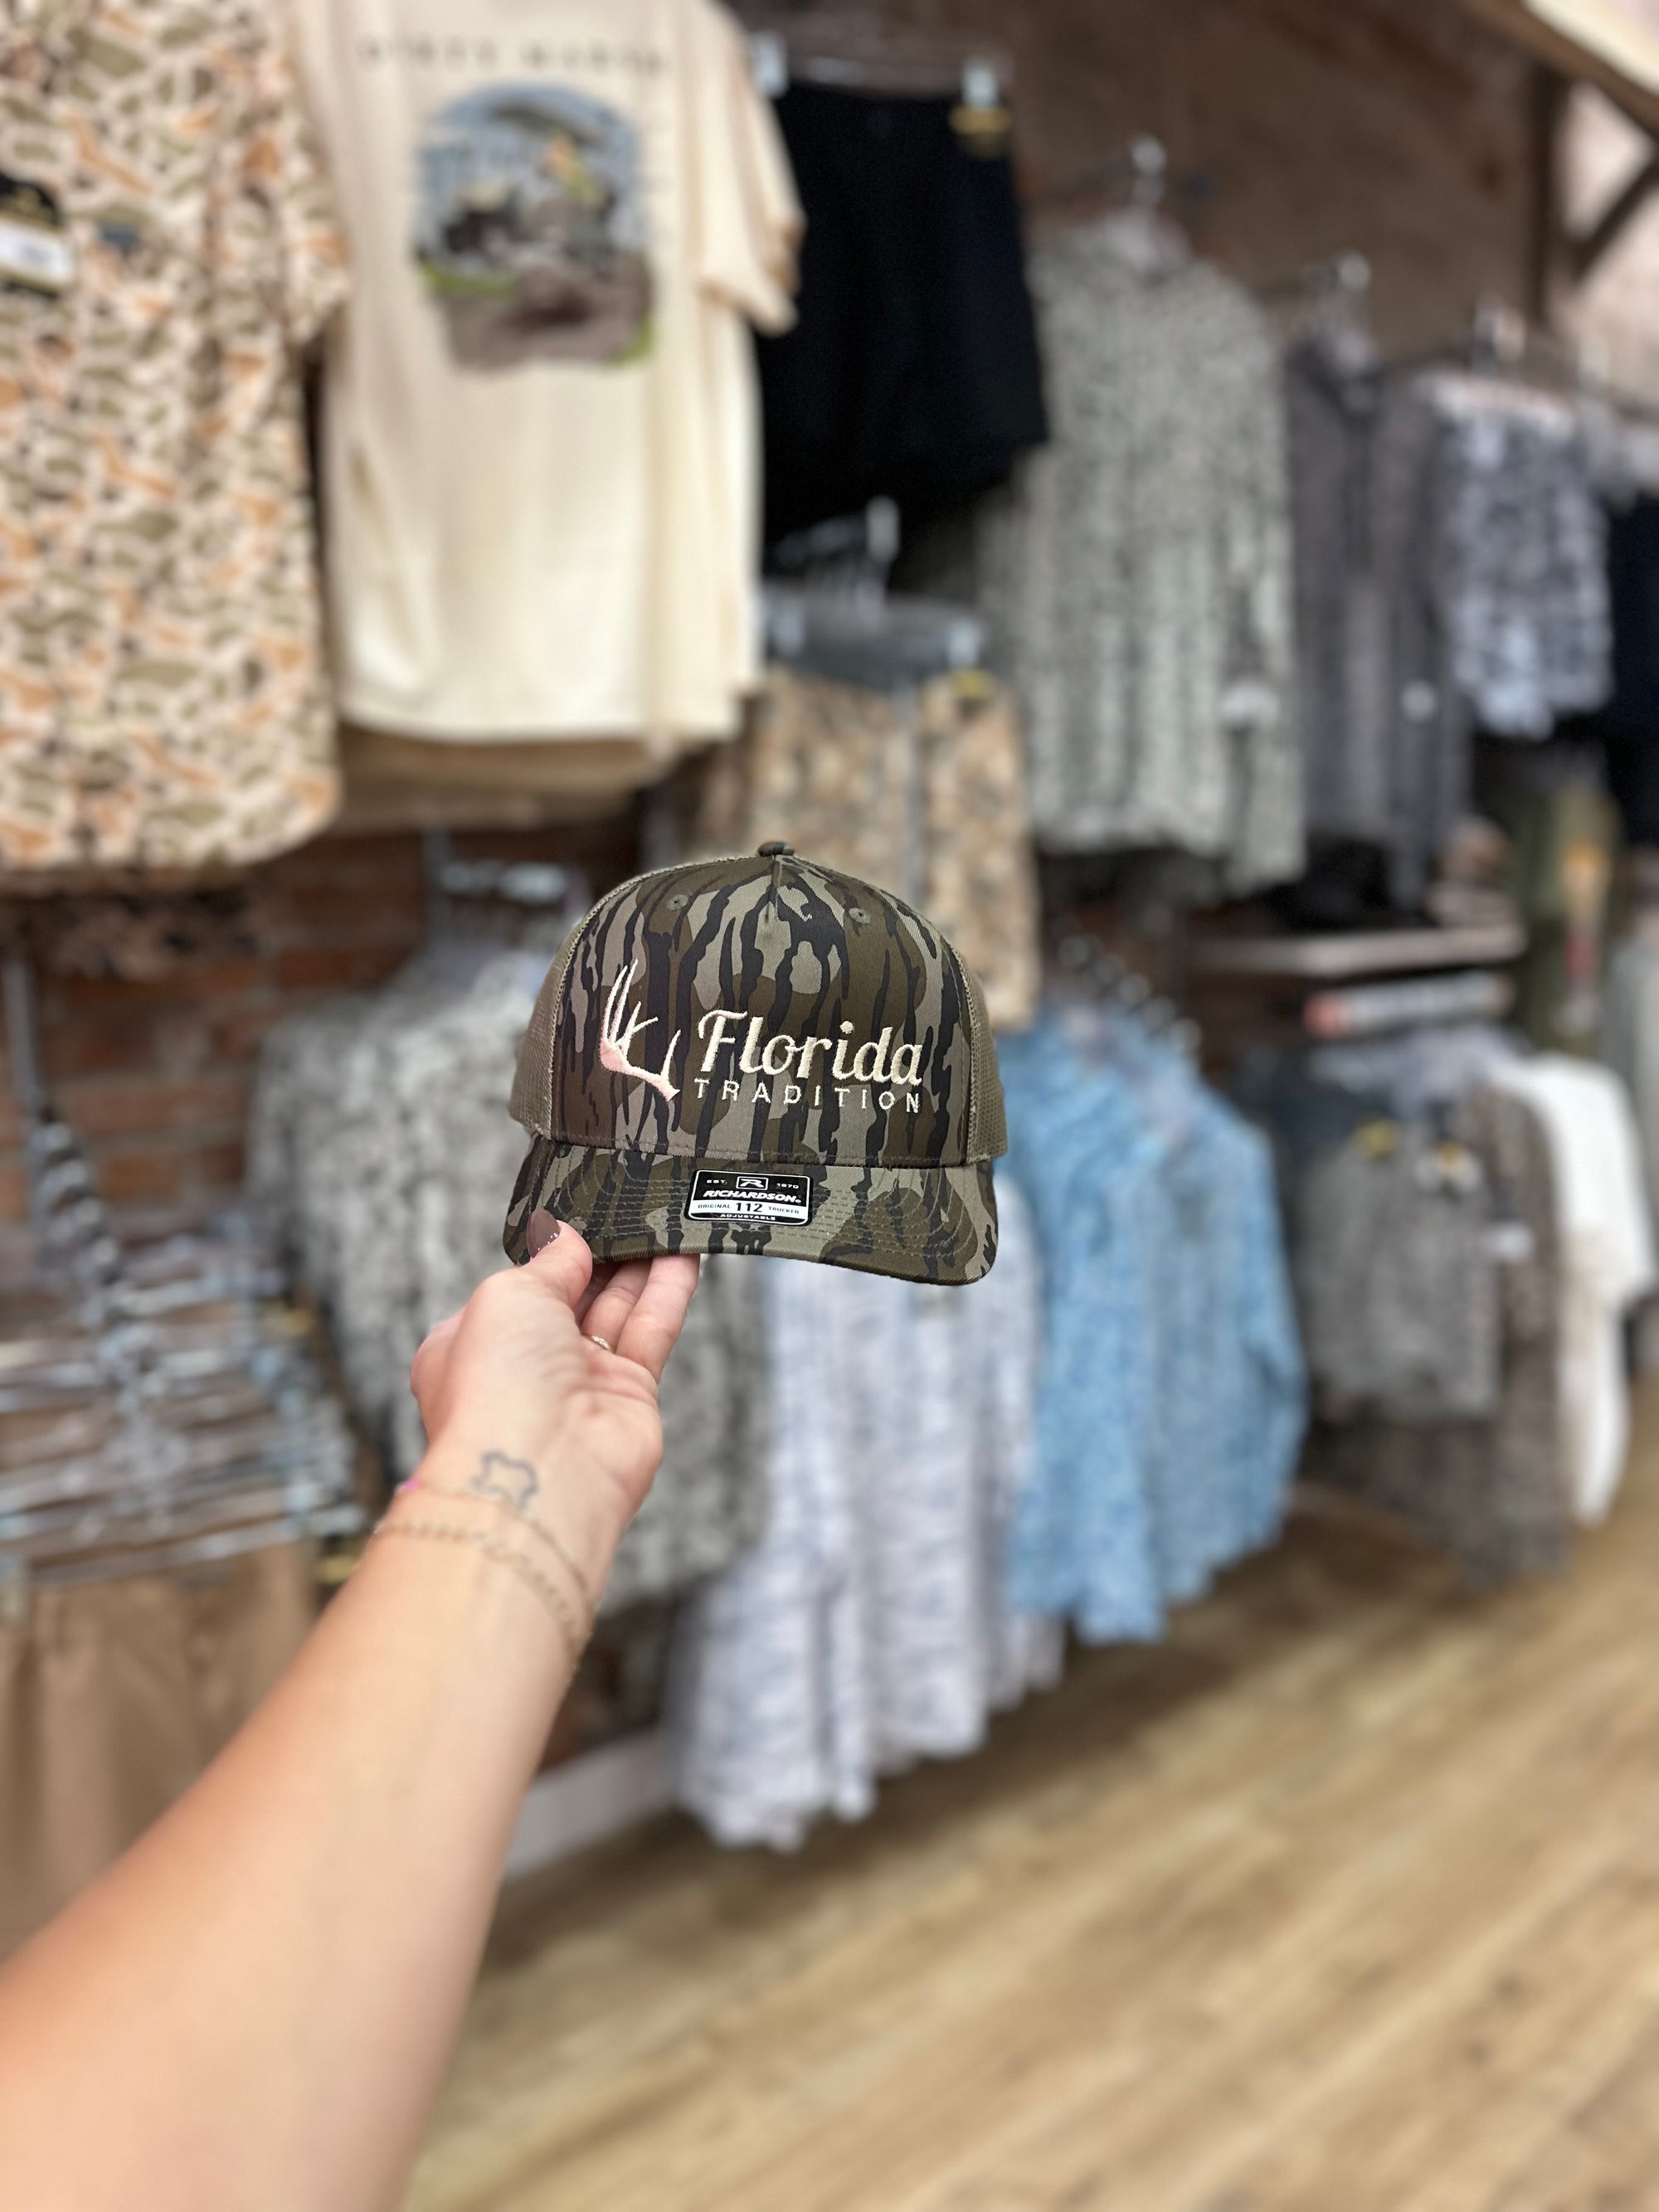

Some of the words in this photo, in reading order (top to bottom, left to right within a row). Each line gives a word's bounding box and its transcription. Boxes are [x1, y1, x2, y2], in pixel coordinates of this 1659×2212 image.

[698, 1009, 922, 1086] Florida
[694, 1077, 922, 1113] TRADITION
[736, 1202, 763, 1213] 112
